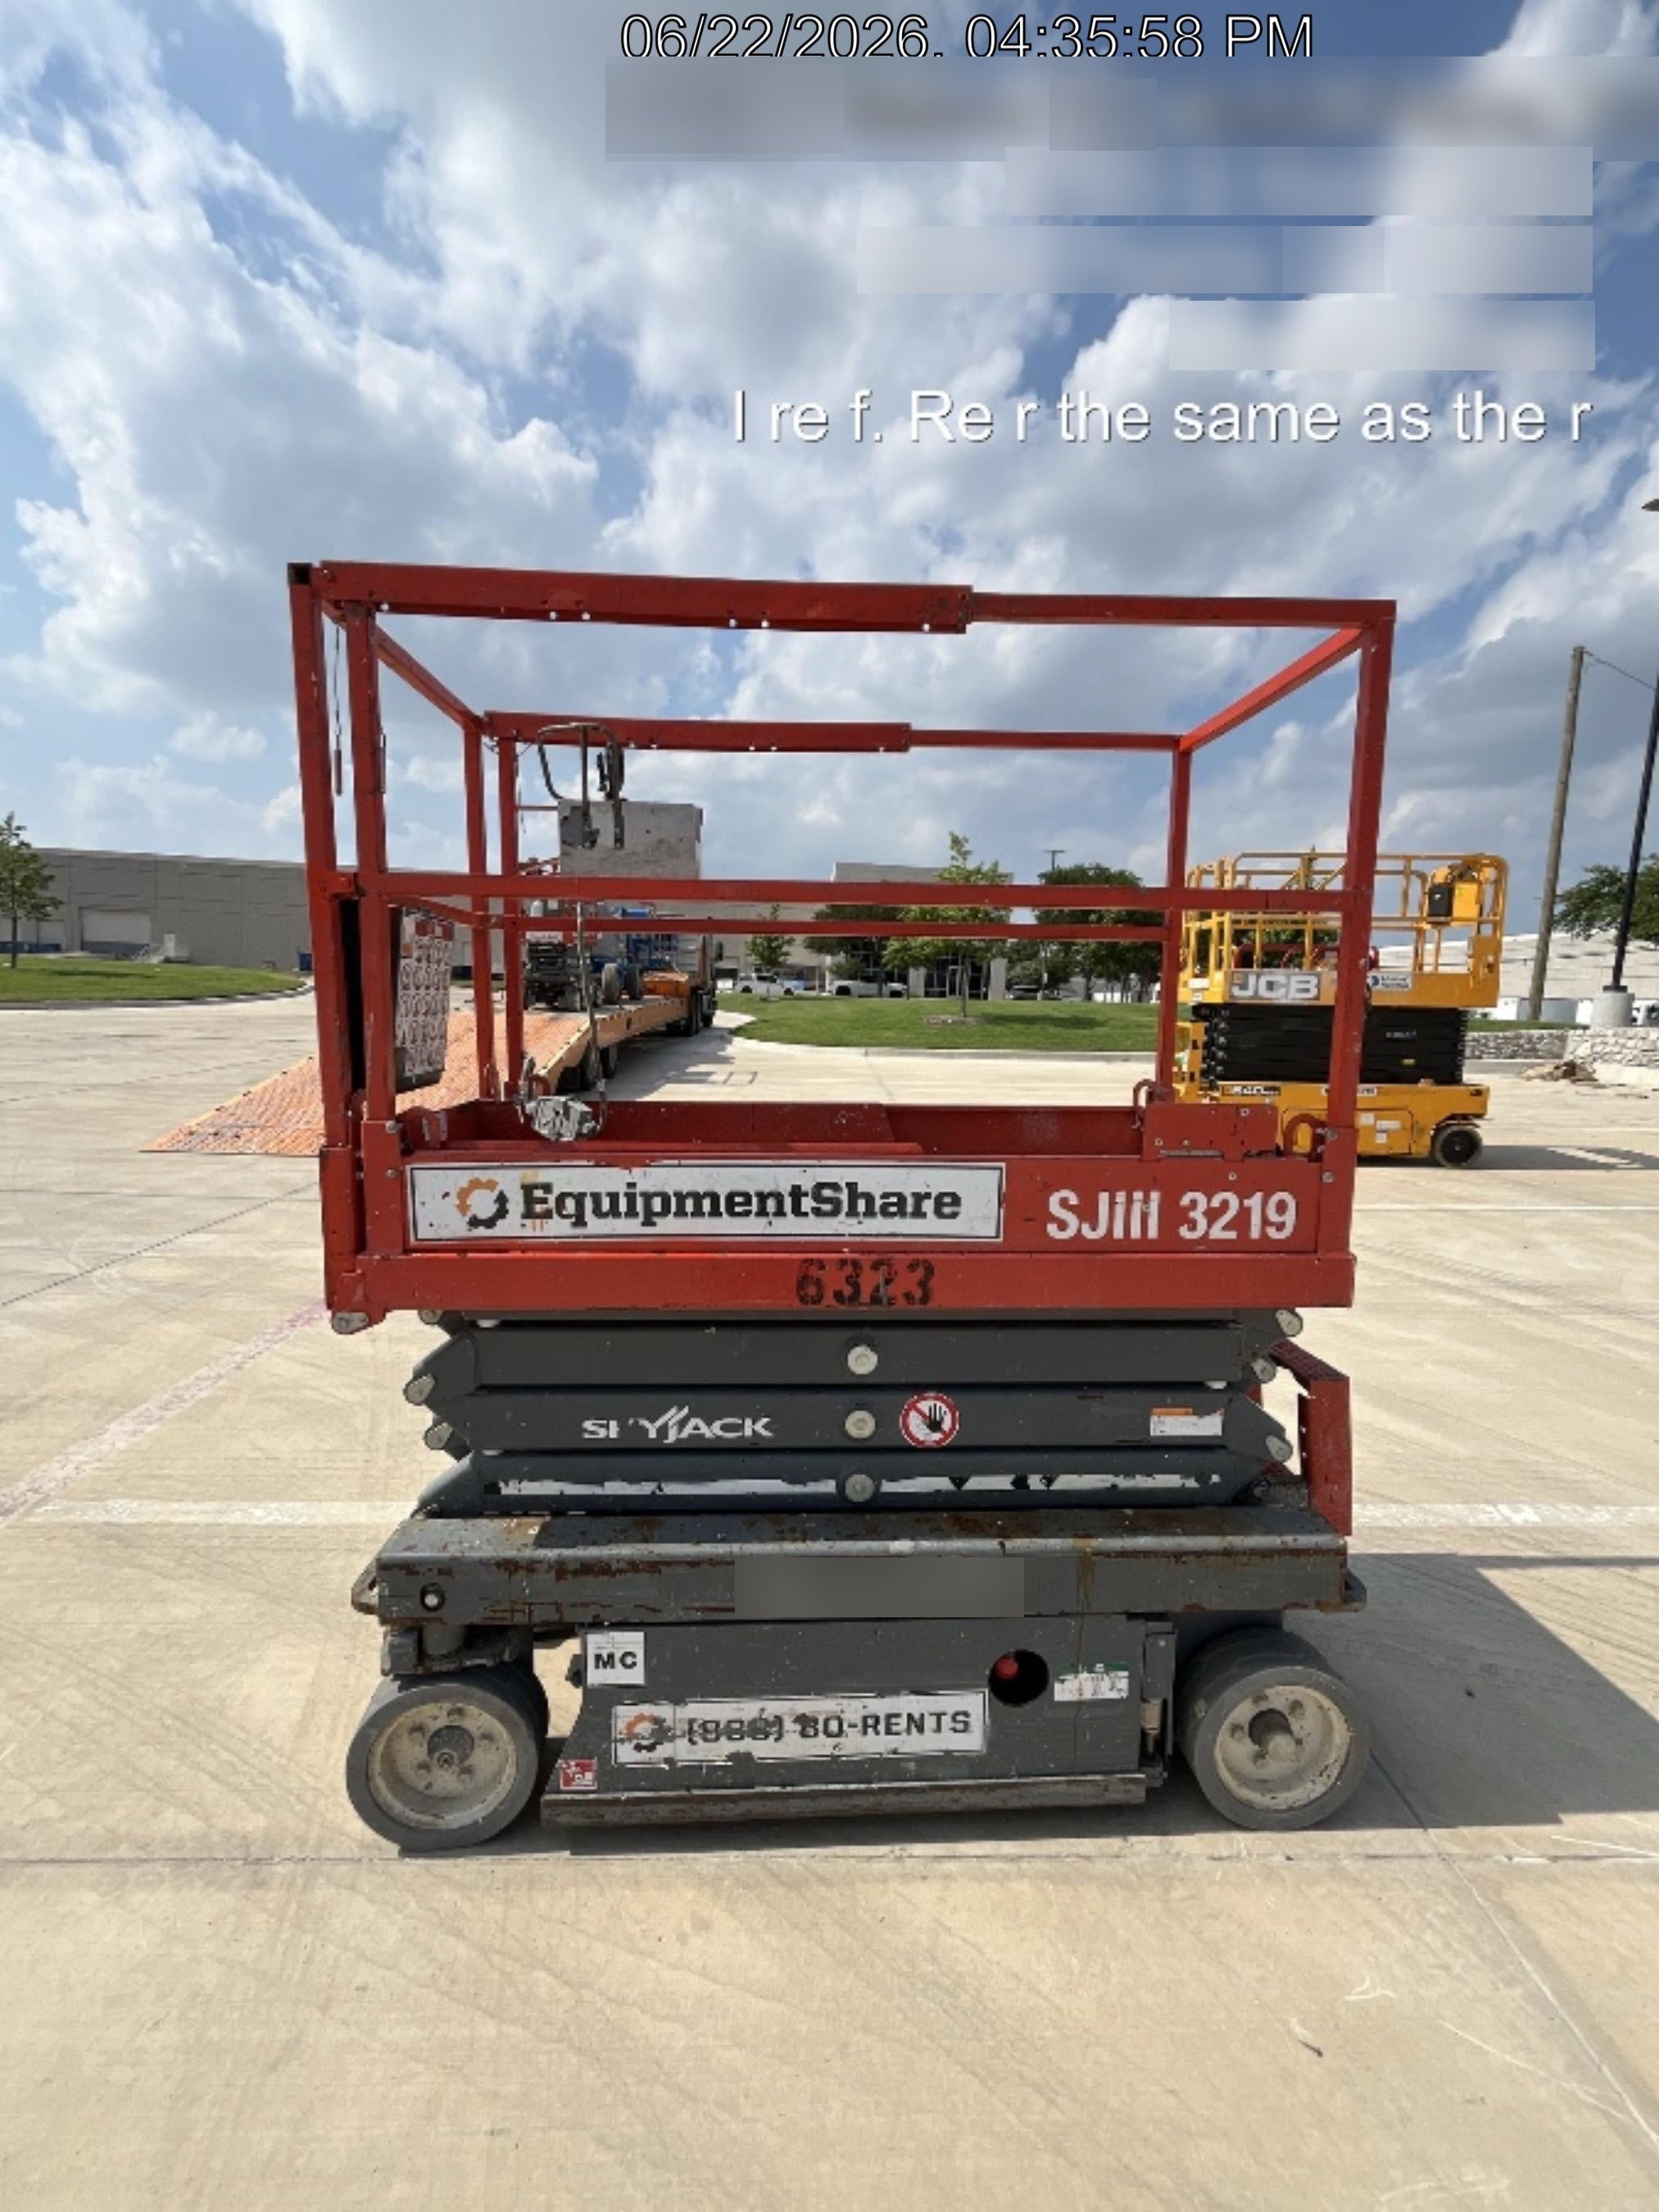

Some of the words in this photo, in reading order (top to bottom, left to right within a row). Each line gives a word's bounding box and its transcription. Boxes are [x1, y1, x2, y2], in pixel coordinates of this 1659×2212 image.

[1231, 972, 1319, 999] JCB
[519, 1181, 962, 1226] EquipmentShare
[1179, 1190, 1297, 1240] 3219
[796, 1258, 935, 1305] 6323
[594, 1651, 637, 1670] MC
